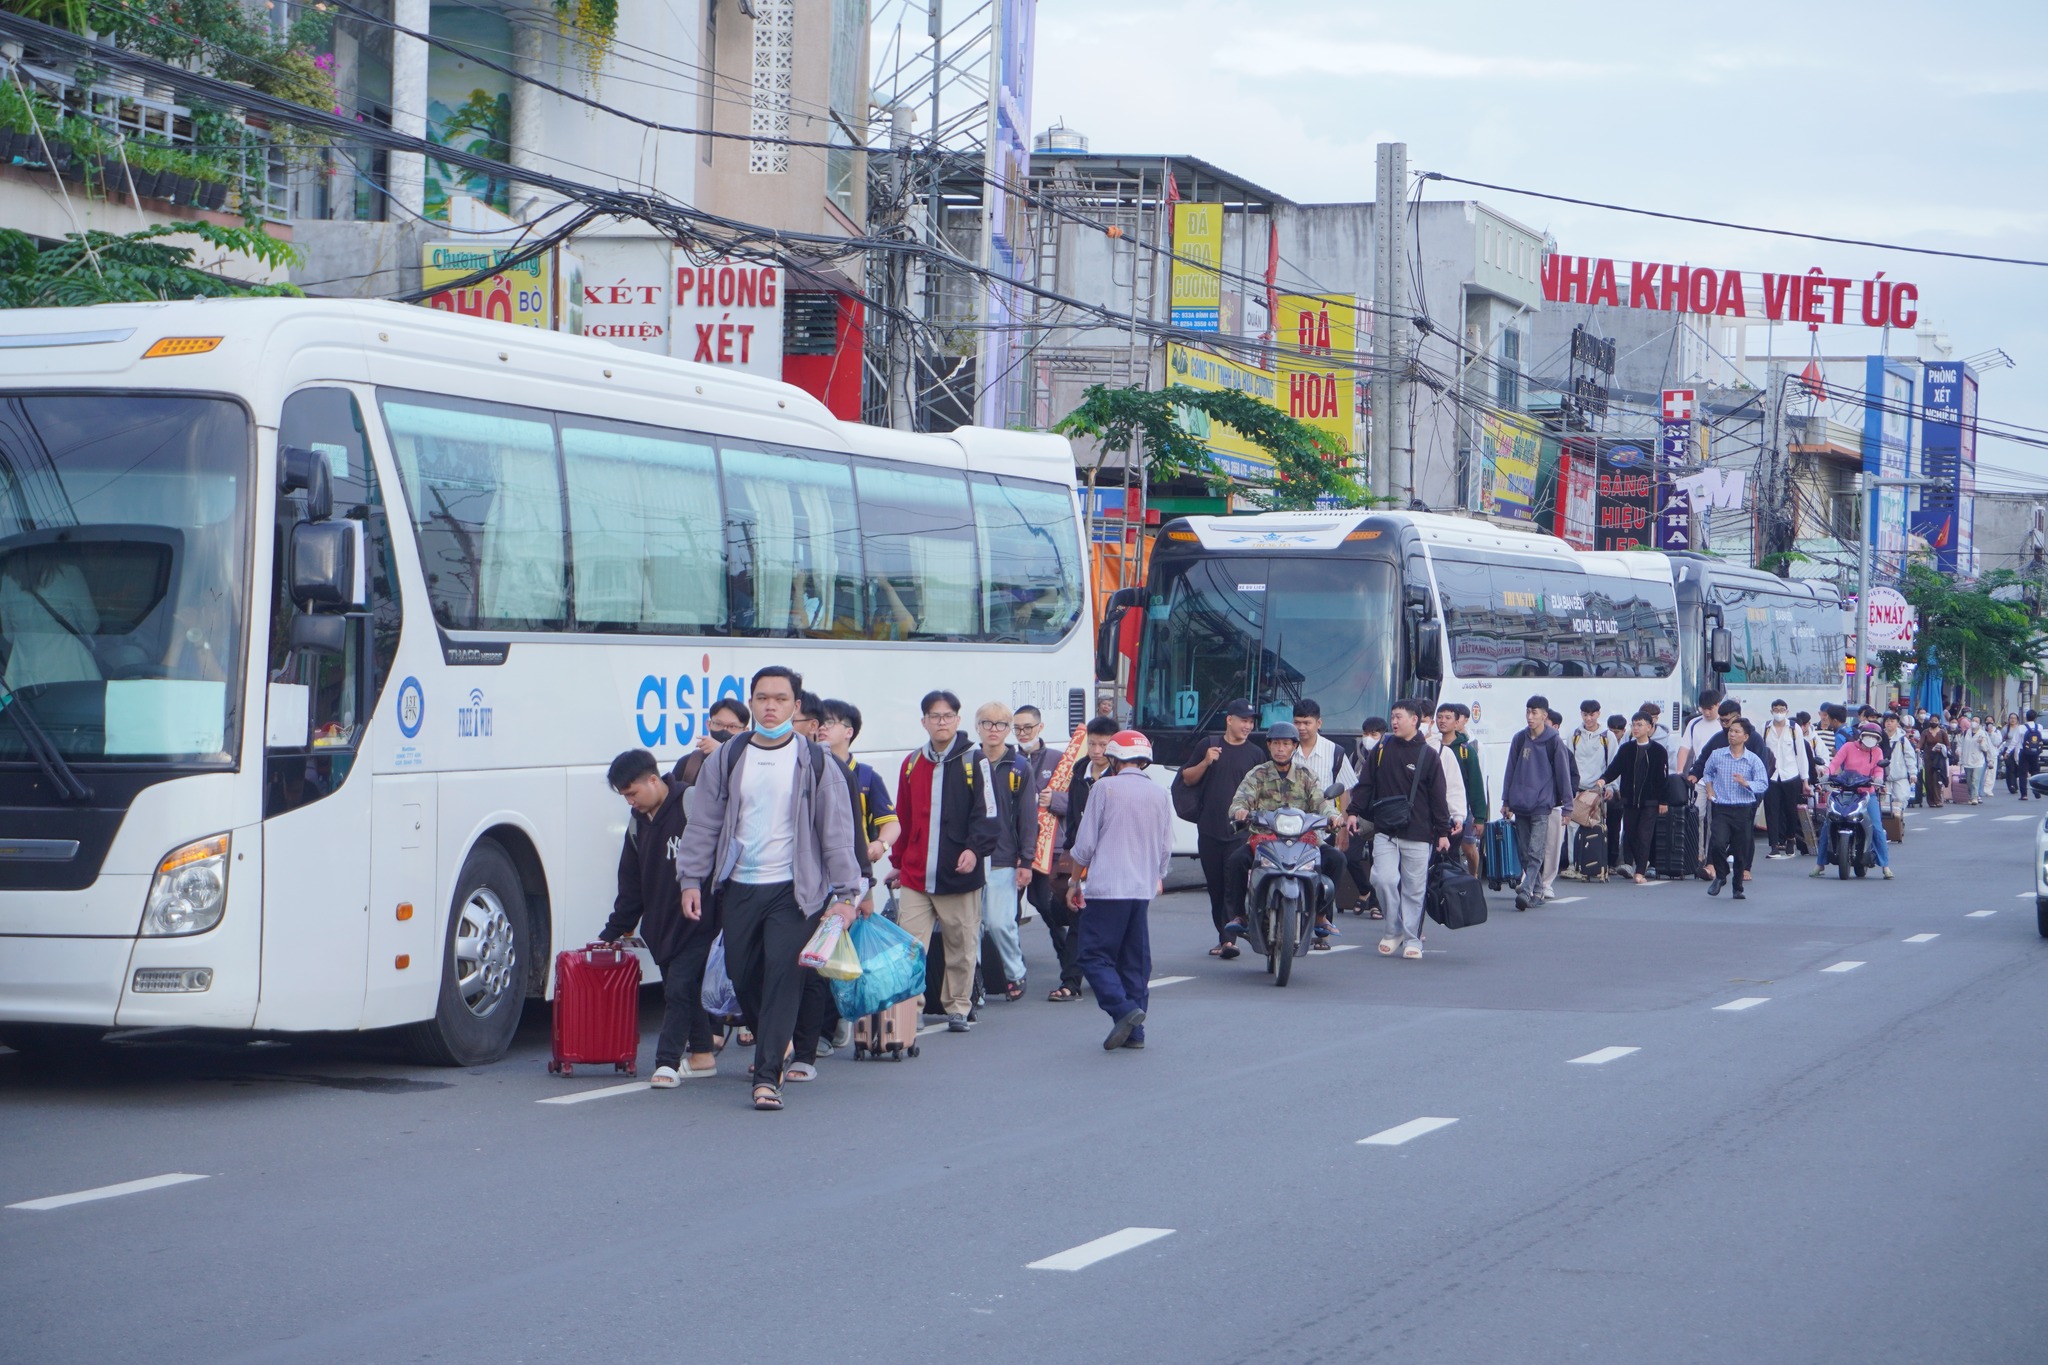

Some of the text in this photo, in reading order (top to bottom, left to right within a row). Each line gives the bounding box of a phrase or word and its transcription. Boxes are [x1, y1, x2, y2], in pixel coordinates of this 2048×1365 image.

[1188, 208, 1208, 236] ĐÁ
[1182, 243, 1212, 267] HOA
[584, 278, 662, 305] XÉT
[677, 256, 776, 307] PHÒNG
[519, 286, 542, 313] BÒ
[1630, 261, 1746, 318] KHOA
[1762, 267, 1852, 331] VIỆT
[1862, 271, 1919, 329] ÚC
[693, 313, 755, 364] XÉT
[1298, 301, 1332, 355] ĐÁ
[1928, 366, 1957, 383] PHÒNG
[1290, 372, 1338, 418] HOA
[1934, 386, 1951, 403] XÉT
[1600, 469, 1649, 497] BẢNG
[1601, 503, 1646, 533] HIỆU
[1883, 602, 1906, 625] MÁY
[1178, 694, 1196, 719] 12
